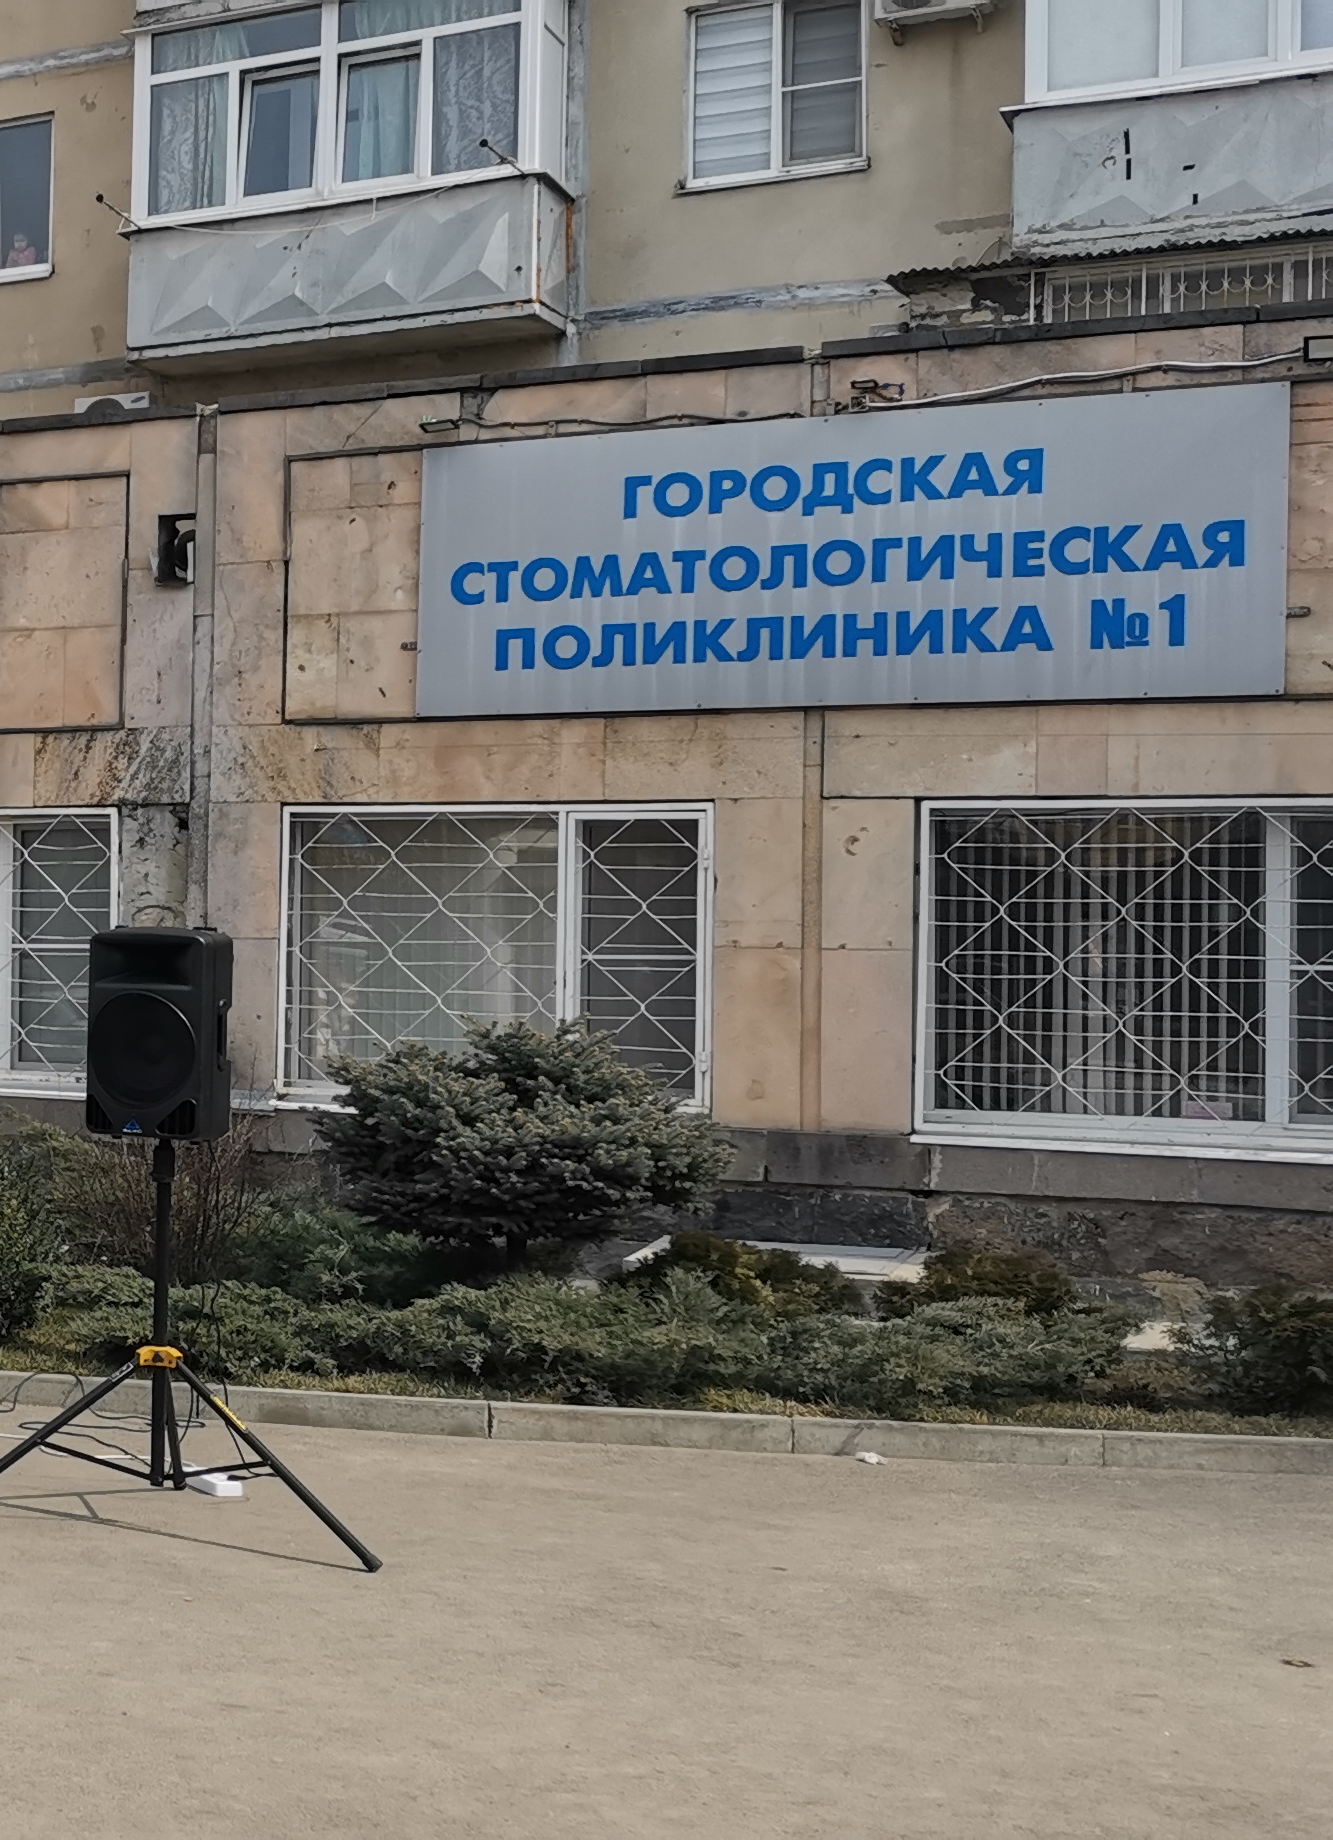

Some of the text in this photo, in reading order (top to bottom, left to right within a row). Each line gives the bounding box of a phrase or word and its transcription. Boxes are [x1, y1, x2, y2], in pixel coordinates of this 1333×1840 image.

[623, 447, 1045, 519] ГОРОДСКАЯ
[450, 519, 1246, 606] СТОМАТОЛОГИЧЕСКАЯ
[495, 593, 1186, 671] ПОЛИКЛИНИКА №1
